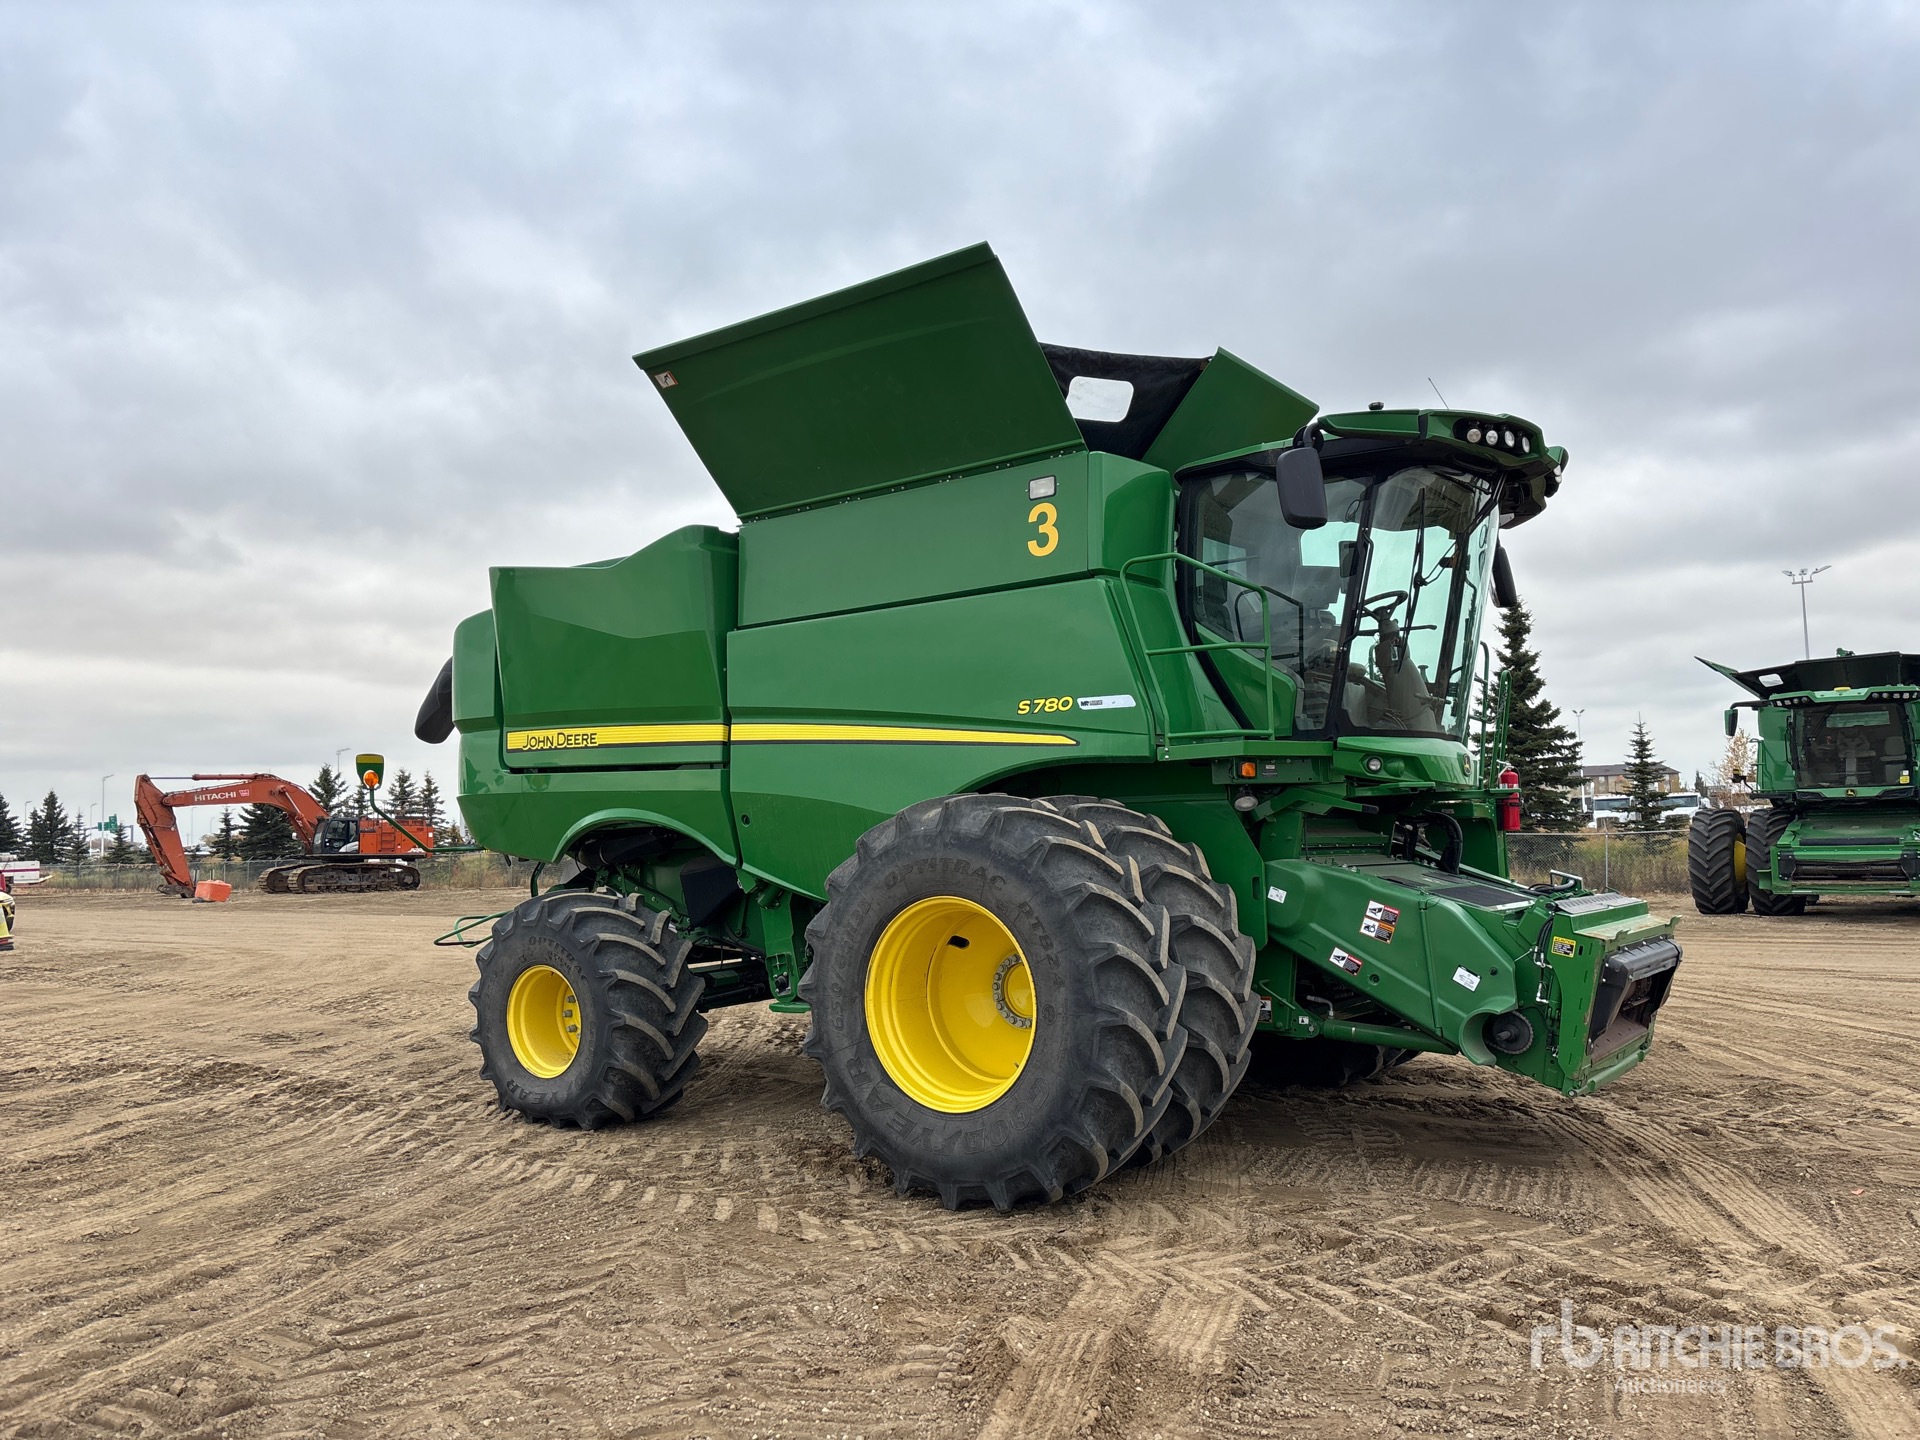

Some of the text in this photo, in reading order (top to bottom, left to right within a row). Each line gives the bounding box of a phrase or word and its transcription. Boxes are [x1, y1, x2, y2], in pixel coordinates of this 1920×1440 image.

[1027, 502, 1059, 557] 3
[1017, 695, 1074, 715] S780
[522, 732, 598, 749] JOHN DEERE
[194, 791, 237, 802] HITACHI
[885, 857, 1065, 987] OPTITRAC DT824
[846, 1056, 1050, 1156] GOODYEAR
